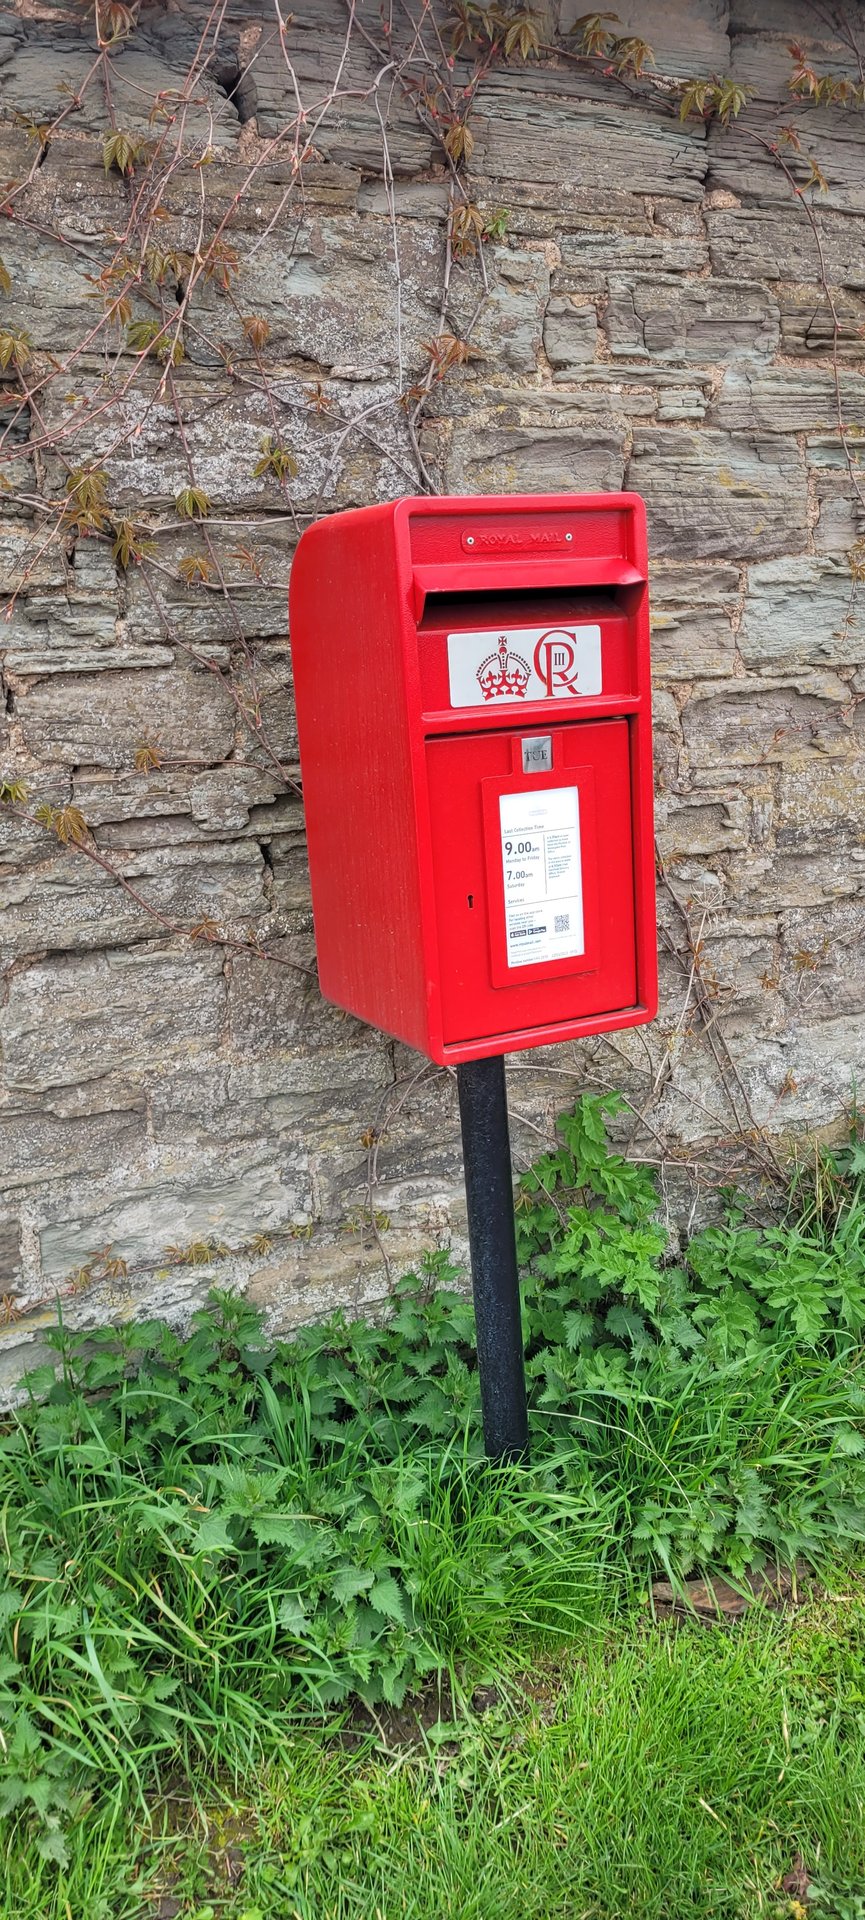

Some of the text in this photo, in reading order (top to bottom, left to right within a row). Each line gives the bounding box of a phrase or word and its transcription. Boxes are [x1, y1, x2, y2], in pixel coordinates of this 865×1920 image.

[480, 532, 562, 545] ROYAL MAIL
[524, 749, 548, 762] TUE
[505, 841, 540, 856] 9.00am
